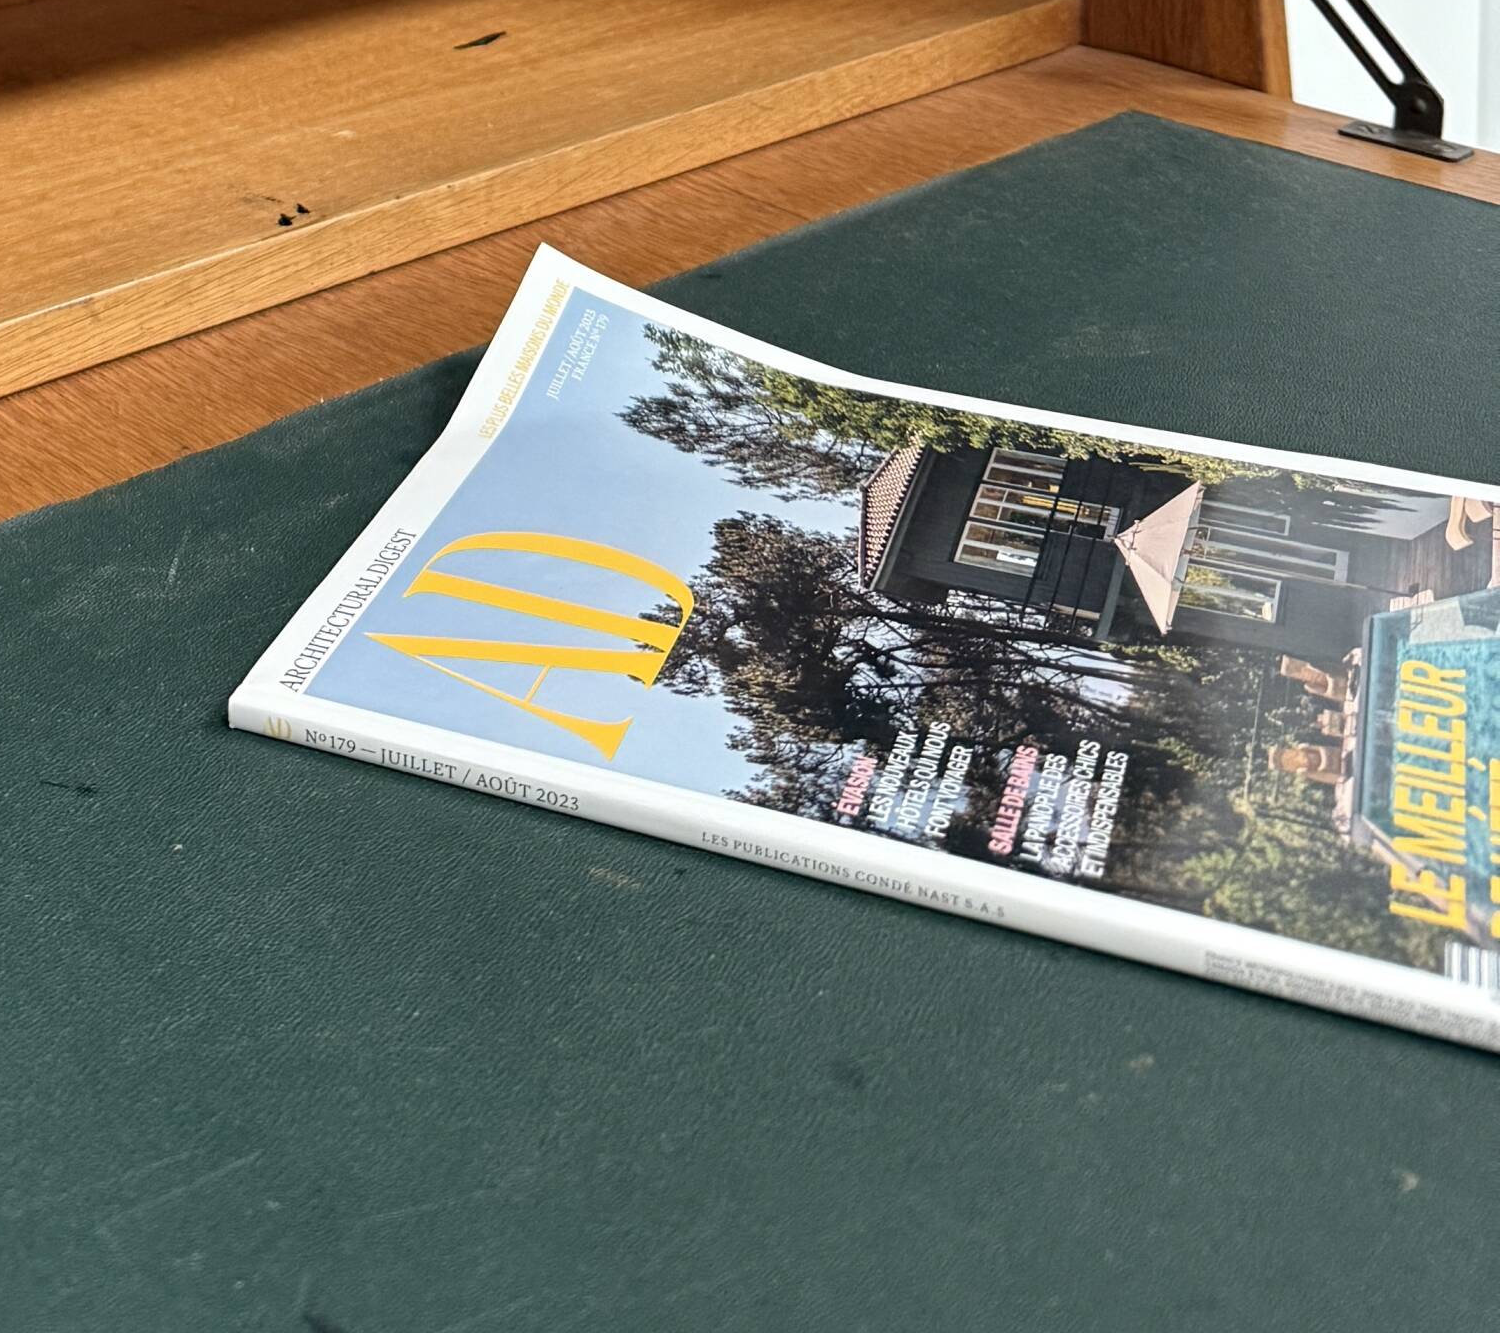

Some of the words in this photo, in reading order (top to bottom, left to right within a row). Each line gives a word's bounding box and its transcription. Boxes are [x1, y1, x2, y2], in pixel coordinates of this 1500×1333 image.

[535, 313, 553, 331] DU
[542, 278, 570, 317] MONDE
[514, 328, 546, 373] MAISONS
[546, 360, 572, 400] JUILLET
[579, 309, 596, 331] 2023
[571, 339, 597, 381] FRANCE
[498, 370, 525, 405] BELLES
[485, 403, 509, 427] PLUS
[279, 577, 382, 692] ARCHITECTURAL
[366, 528, 417, 577] DIGEST
[363, 531, 695, 763] AD
[924, 721, 951, 763] NOUS
[1007, 745, 1038, 788] BAINS
[1042, 753, 1067, 780] DES
[1392, 660, 1467, 864] MEILLEUR
[381, 748, 457, 780] JUILLET
[476, 776, 530, 799] AOÛT
[536, 788, 580, 811] 2023
[831, 756, 878, 816] ÉVASION
[866, 794, 890, 823] LES
[880, 730, 918, 797] NOUVEAUX
[914, 756, 940, 783] QUI
[937, 745, 973, 797] VOYAGER
[894, 778, 930, 830] HÔTELS
[925, 792, 951, 838] FONT
[1002, 785, 1027, 808] DE
[1025, 777, 1060, 840] PANOPLIE
[1049, 778, 1092, 867] ACCESSOIRES
[1073, 739, 1101, 779] CHICS
[1085, 750, 1129, 856] INDISPENSABLES
[988, 806, 1021, 855] SALLE
[1020, 839, 1043, 861] LA
[702, 831, 729, 847] LES
[733, 840, 850, 879] PUBLICATIONS
[855, 870, 912, 893] CONDÉ
[918, 885, 958, 905] NAST
[1080, 853, 1105, 877] ET
[1389, 862, 1466, 930] LE
